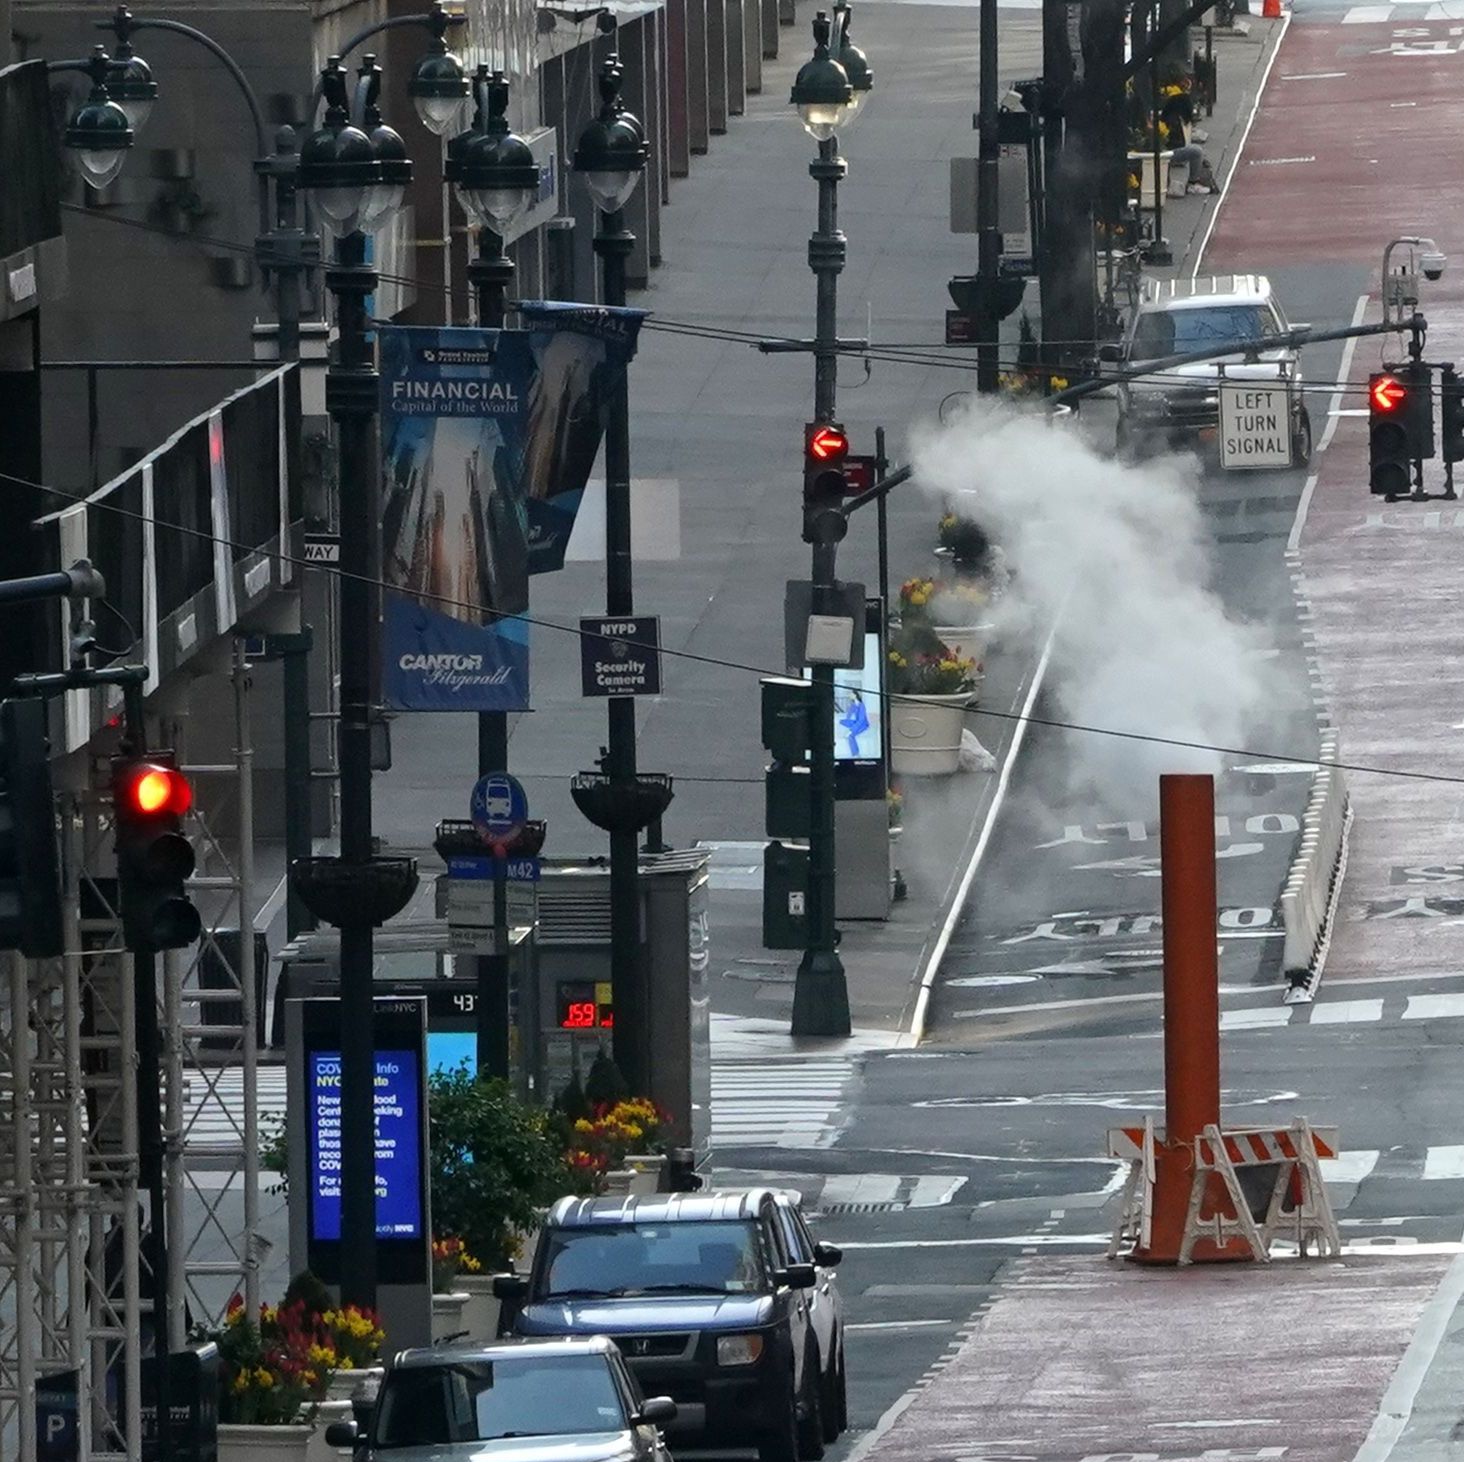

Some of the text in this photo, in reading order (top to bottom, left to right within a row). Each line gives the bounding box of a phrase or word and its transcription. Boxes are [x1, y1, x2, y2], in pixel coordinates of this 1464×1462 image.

[392, 381, 519, 400] FINANCIAL
[392, 400, 519, 415] Capital of the World
[1236, 393, 1273, 410] LEFT
[1234, 414, 1277, 432] TURN
[1227, 437, 1286, 454] SIGNAL
[600, 624, 637, 635] NYPD
[399, 654, 483, 671] CANTOR
[595, 661, 646, 675] Security
[423, 665, 512, 692] Fitzgerald
[596, 674, 646, 686] Camera
[507, 862, 534, 878] M42
[376, 1063, 399, 1074] Info
[319, 1176, 337, 1186] For
[46, 1414, 66, 1443] P
